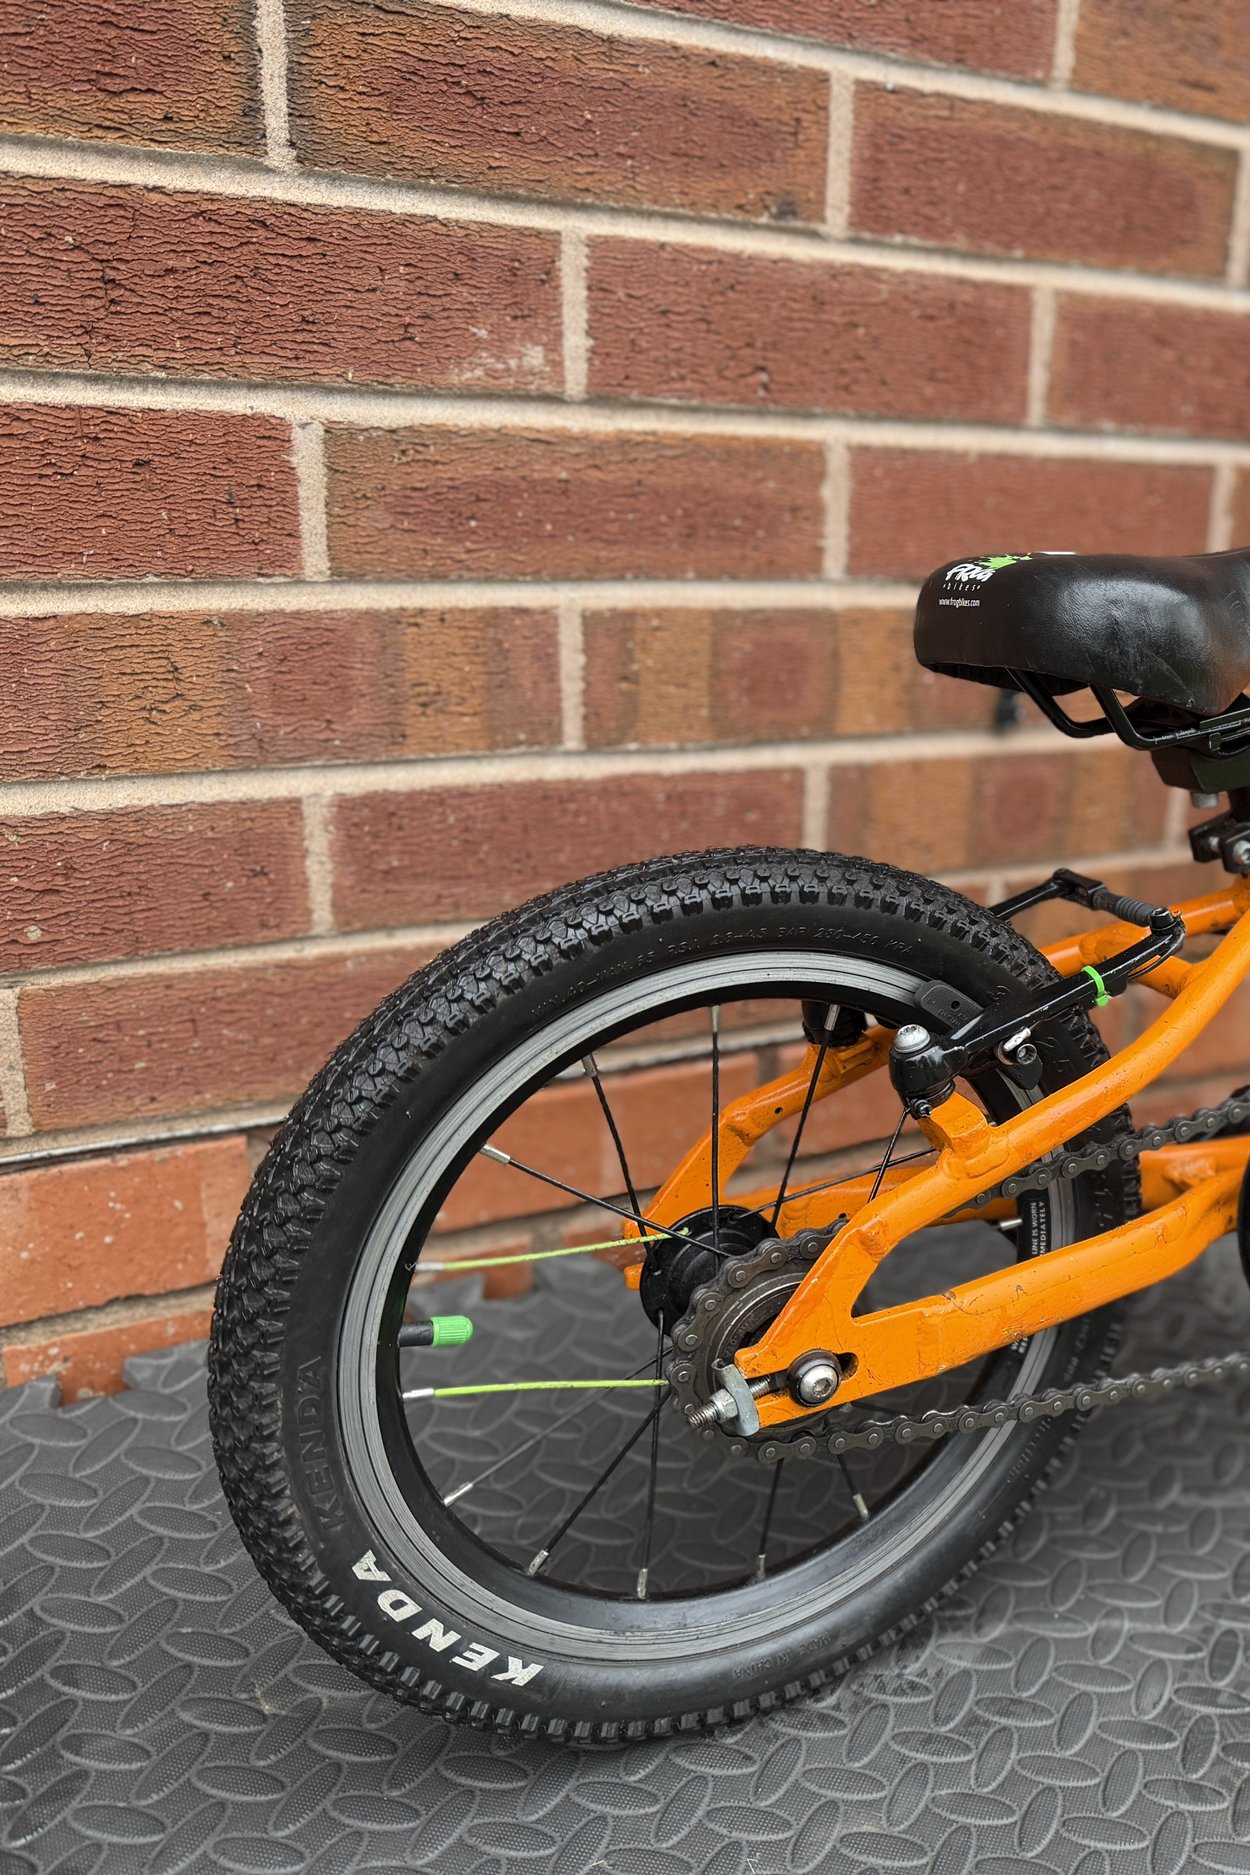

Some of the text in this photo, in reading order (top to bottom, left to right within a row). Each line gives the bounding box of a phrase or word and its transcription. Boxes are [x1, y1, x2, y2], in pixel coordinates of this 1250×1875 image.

[938, 597, 980, 608] www.frogbikes.com
[298, 1356, 346, 1530] KENDA
[351, 1549, 545, 1687] KENDA
